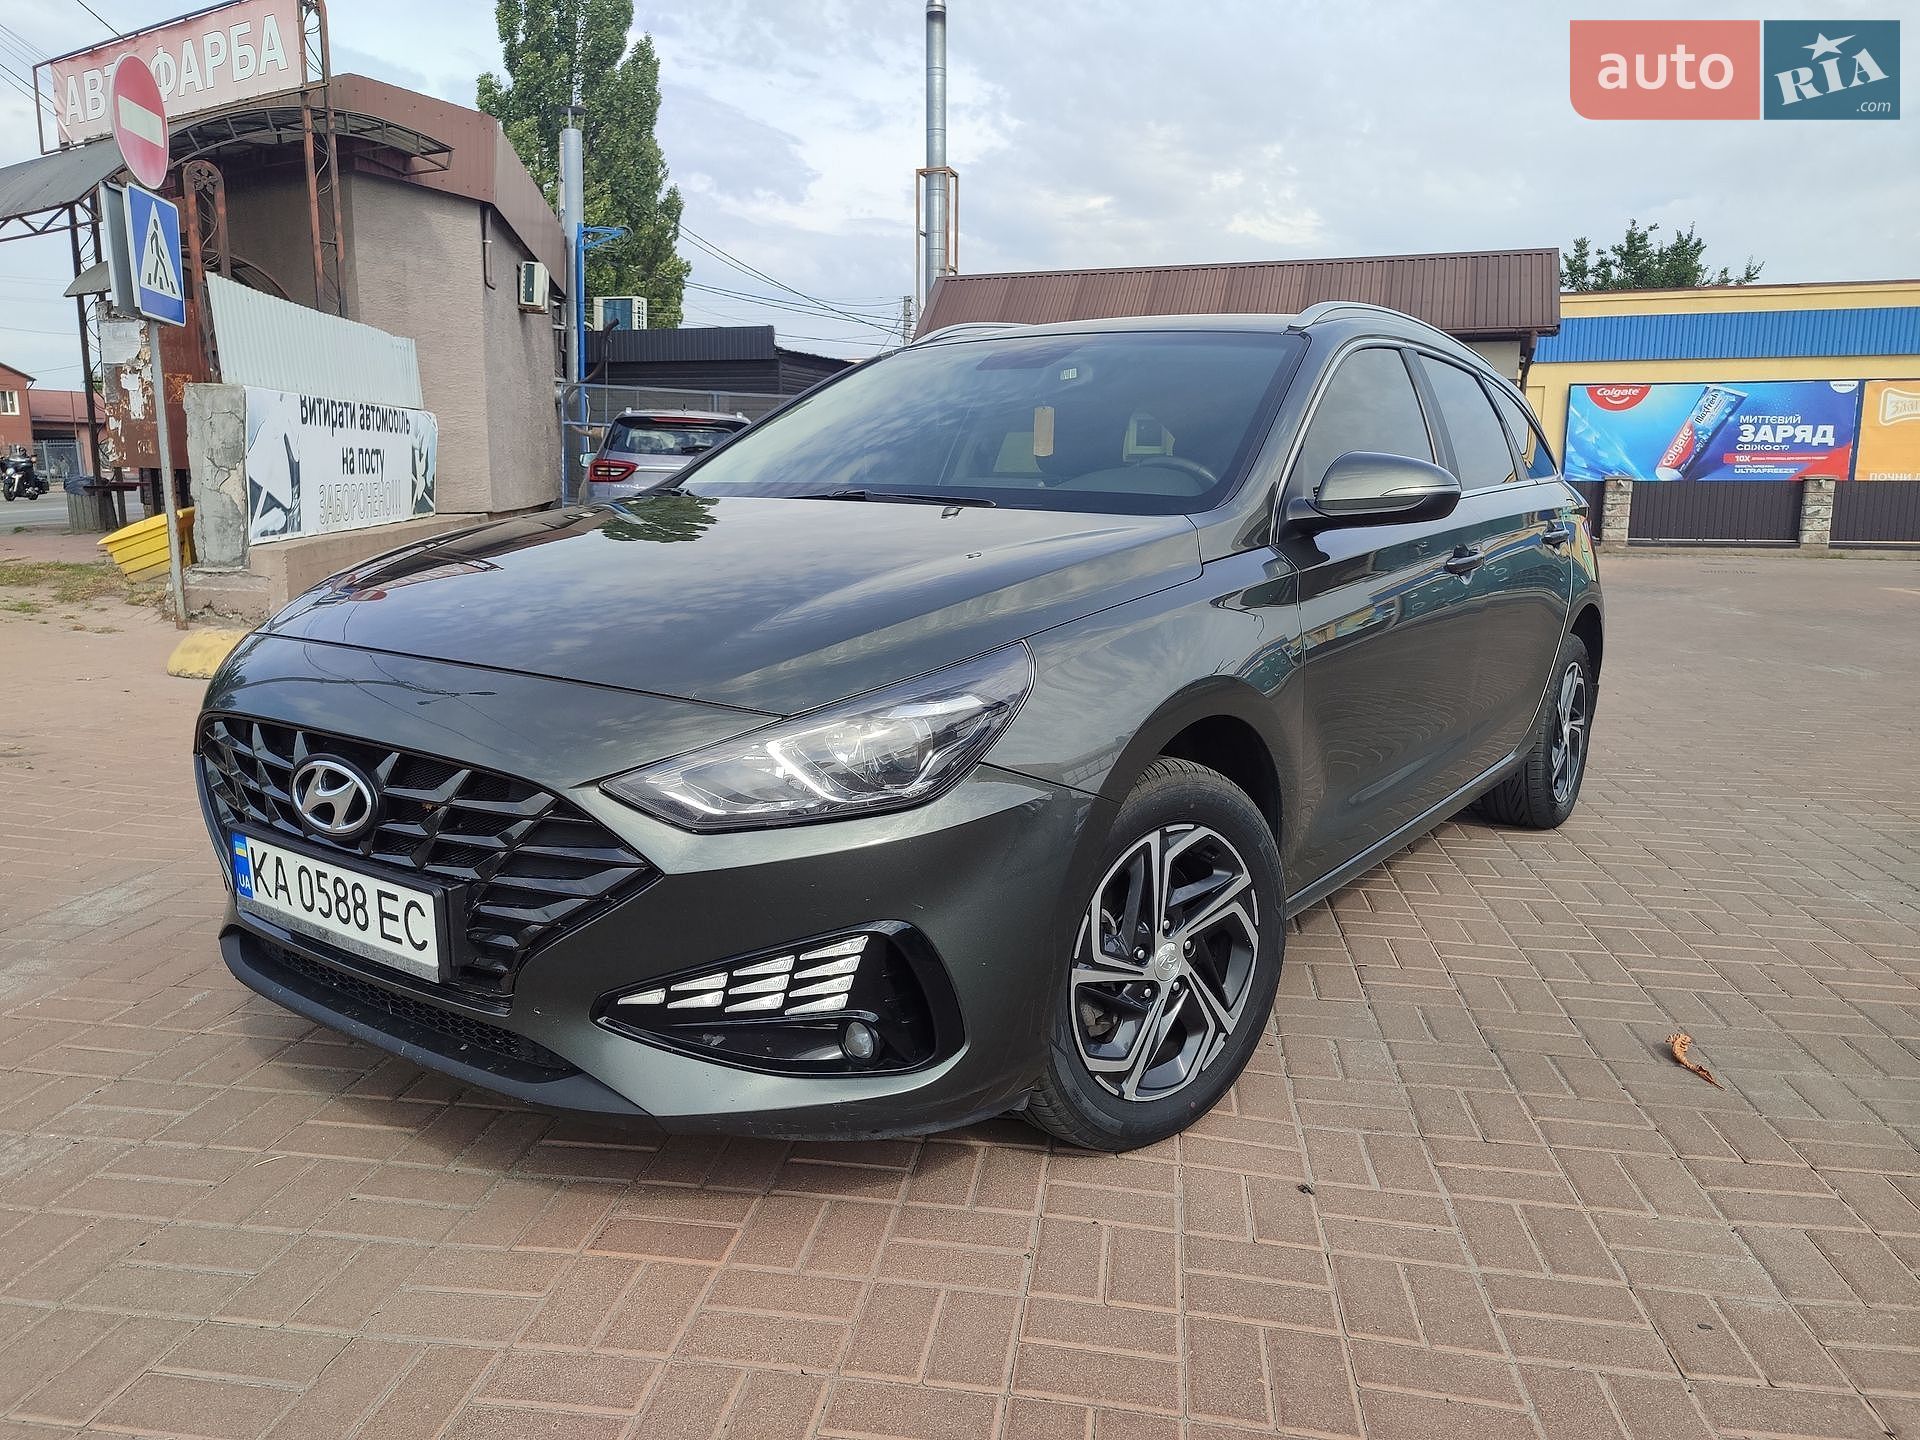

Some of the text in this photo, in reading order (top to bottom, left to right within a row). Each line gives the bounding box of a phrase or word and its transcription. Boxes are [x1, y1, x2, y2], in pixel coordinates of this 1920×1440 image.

[65, 14, 289, 126] АВФАРБА
[1596, 387, 1640, 398] Colgate
[1740, 414, 1802, 424] МИТТЄВИЙ
[1662, 428, 1693, 466] Colgate
[1737, 424, 1835, 446] ЗАРЯД
[342, 446, 385, 482] на посту
[239, 872, 251, 890] UA
[250, 846, 428, 951] KA 0588 EC
